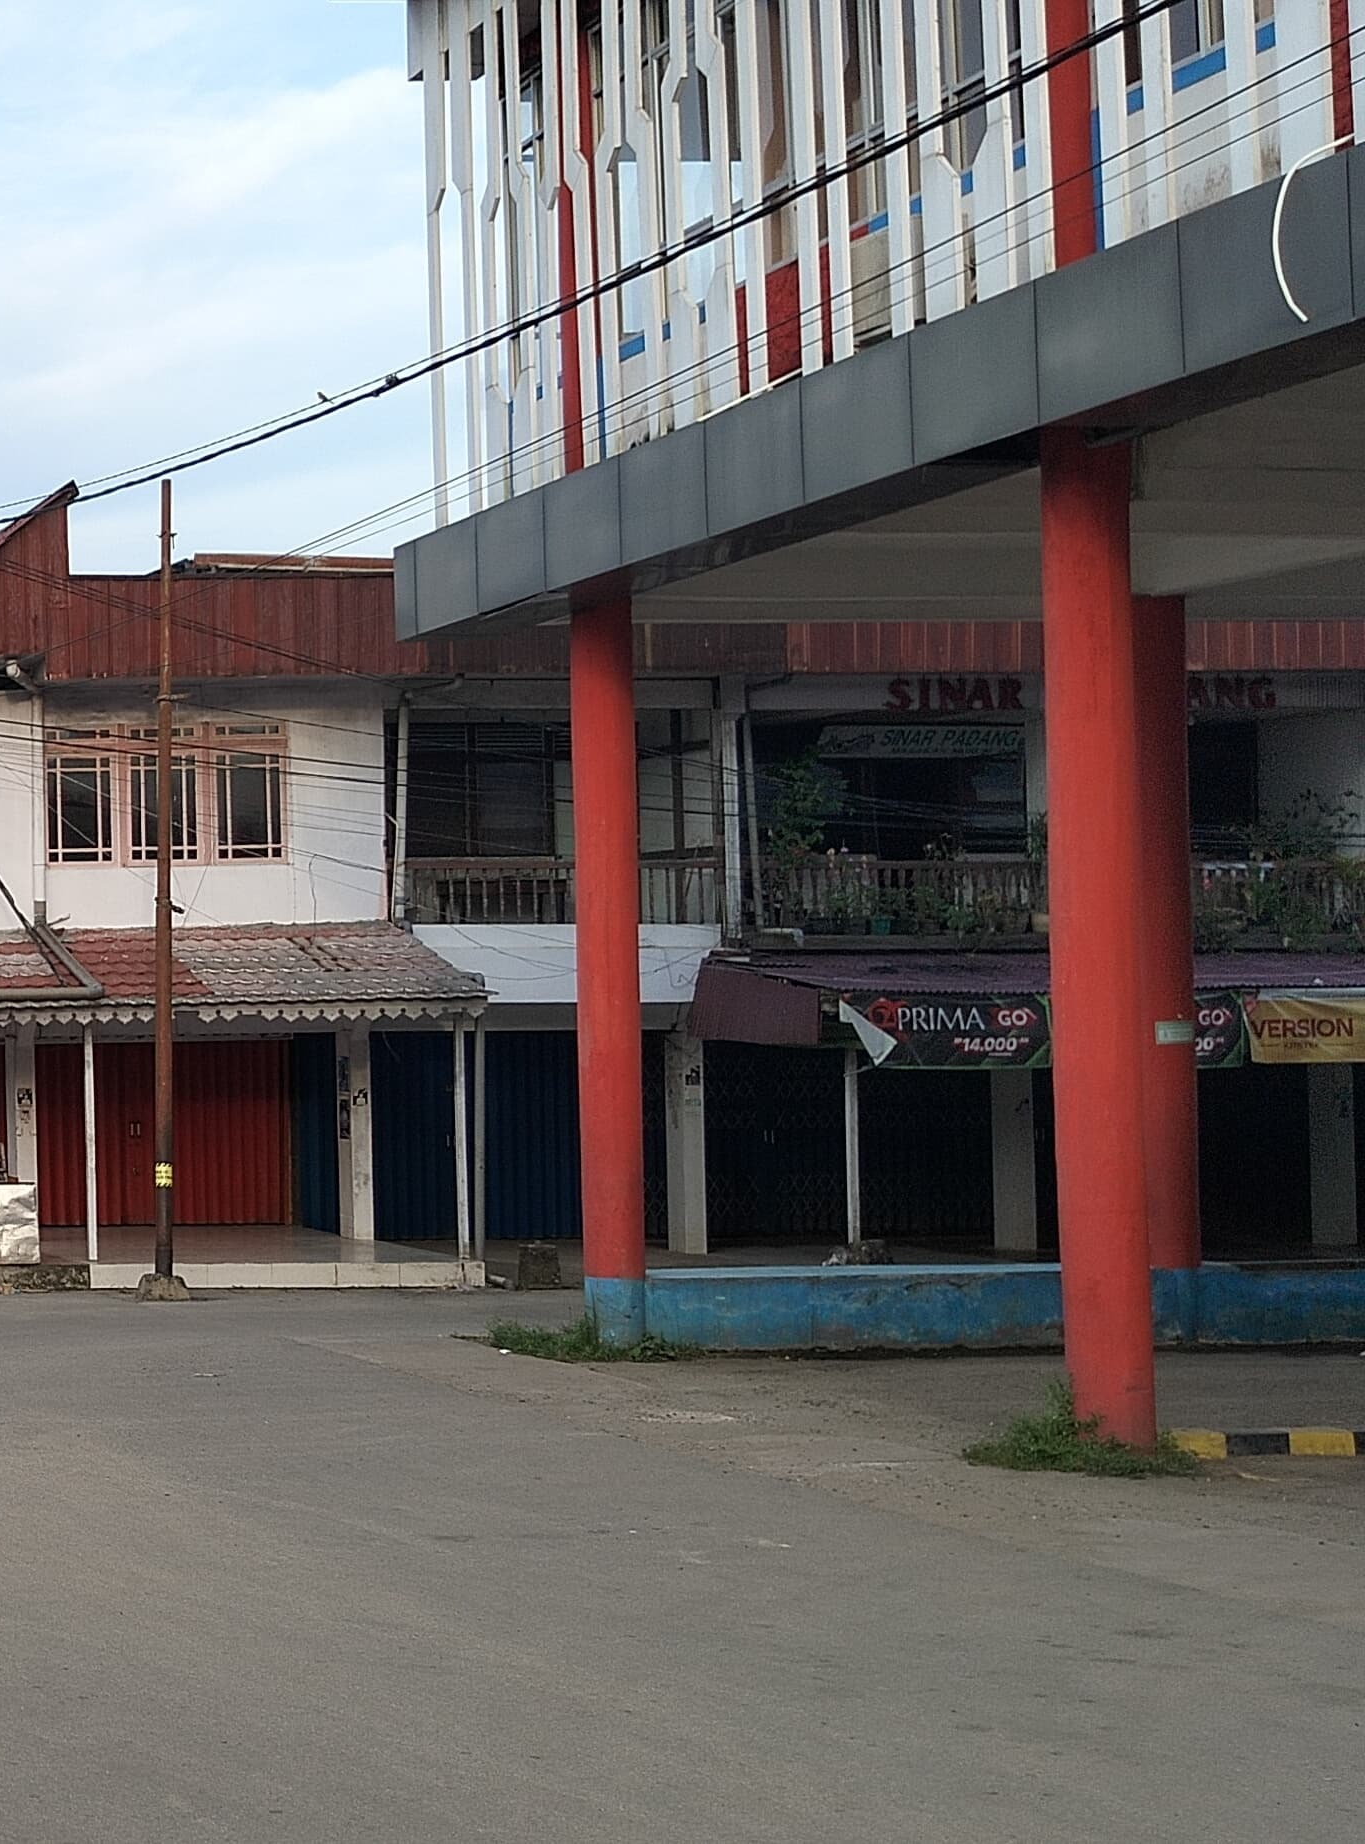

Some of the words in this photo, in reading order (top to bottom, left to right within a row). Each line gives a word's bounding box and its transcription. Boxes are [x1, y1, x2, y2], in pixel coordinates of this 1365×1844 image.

[885, 678, 1023, 711] SINAR
[880, 729, 934, 746] SINAR
[940, 729, 1020, 746] PADANG
[897, 1006, 986, 1032] PRIMA
[997, 1009, 1028, 1026] GO
[1198, 1009, 1225, 1026] GO
[1250, 1017, 1354, 1040] VERSION
